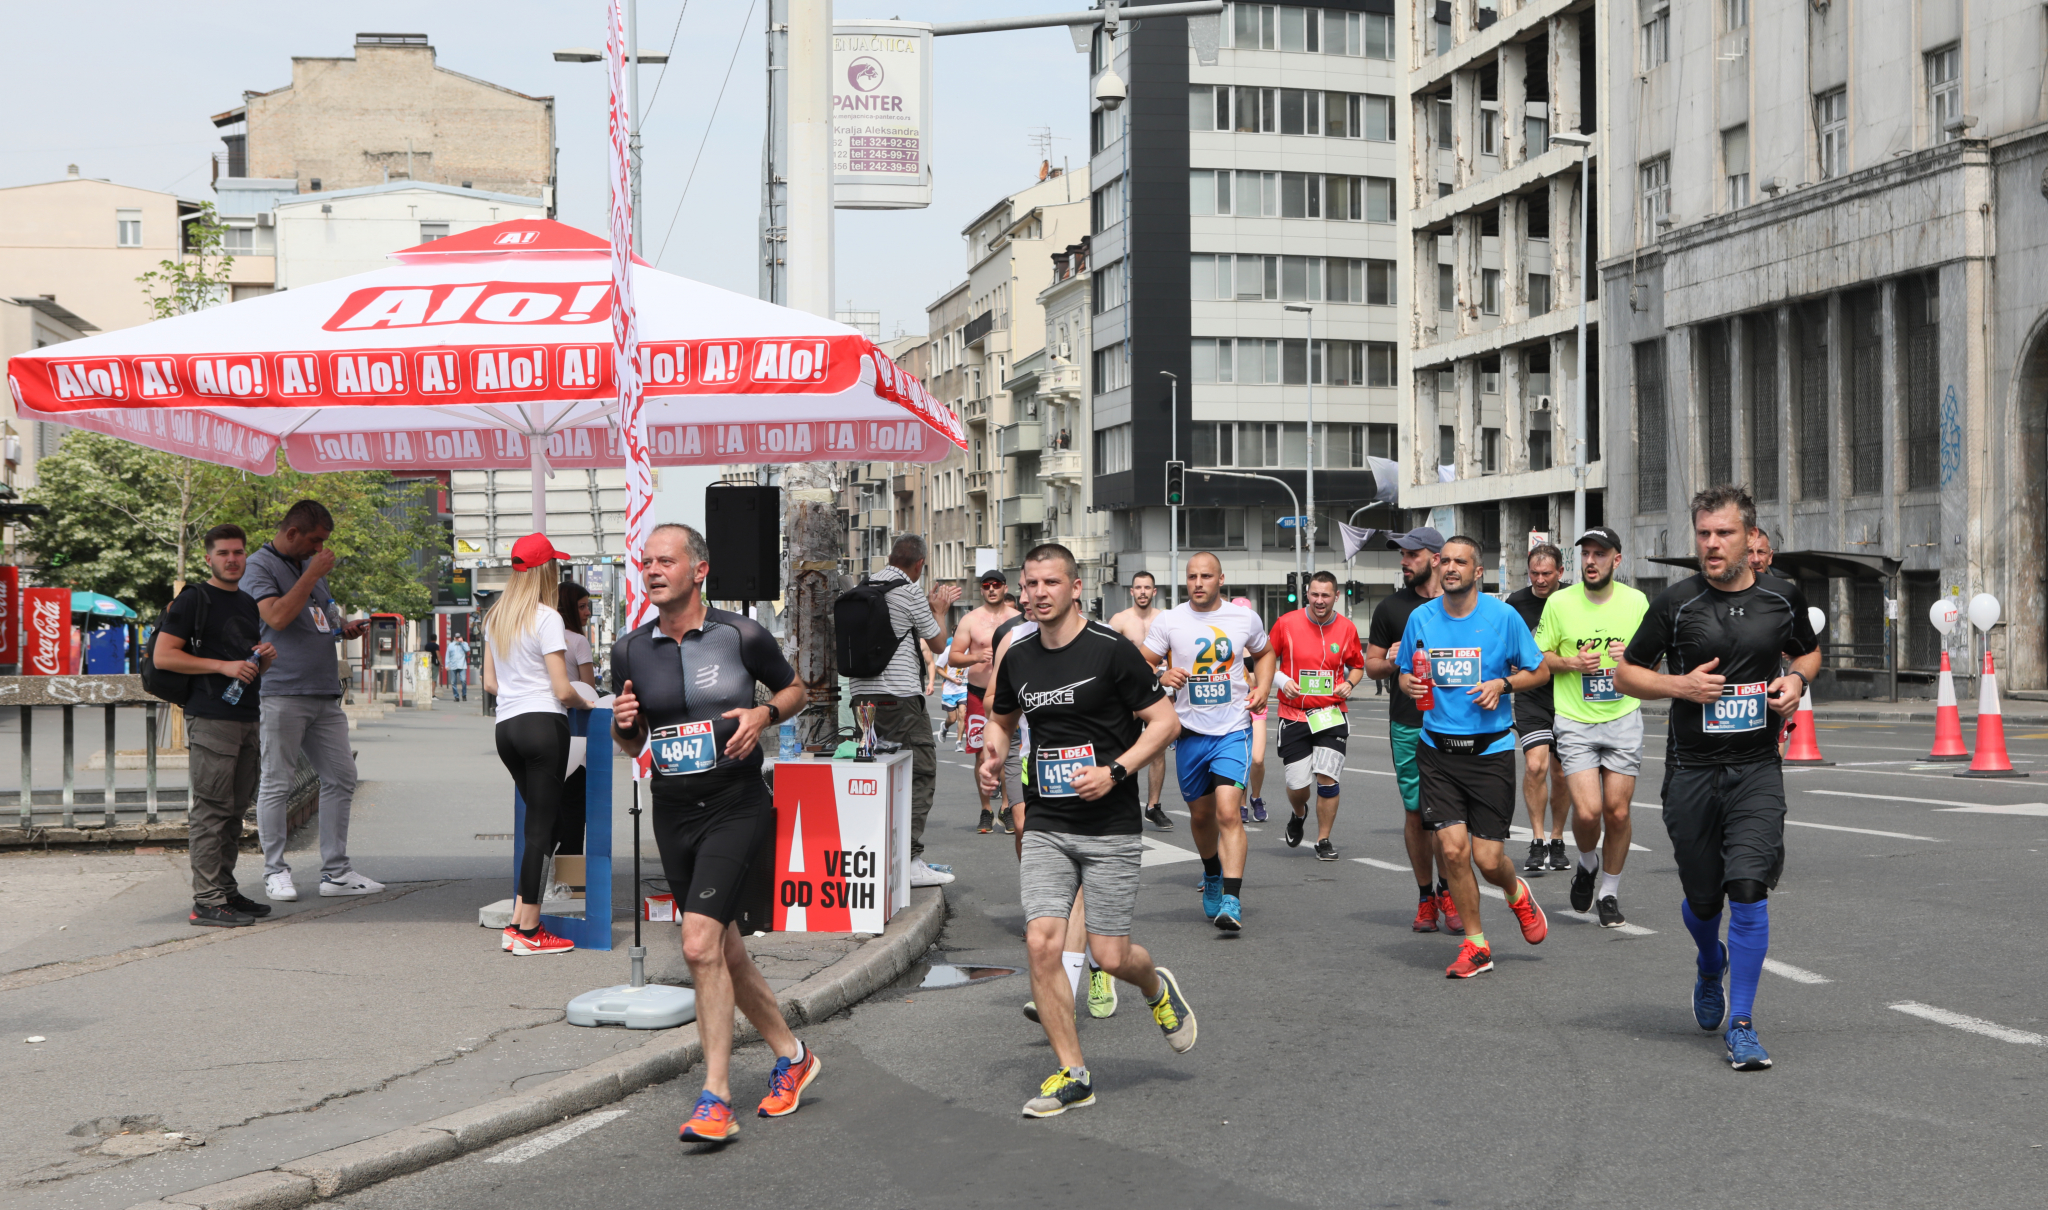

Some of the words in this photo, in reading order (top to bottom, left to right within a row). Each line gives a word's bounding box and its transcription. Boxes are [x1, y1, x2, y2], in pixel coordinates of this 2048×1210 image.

[833, 35, 915, 53] ENJAČNICA
[833, 94, 903, 112] PANTER
[833, 113, 911, 121] w.menjacnica-panter.co.rs
[834, 125, 862, 136] Kralja
[864, 125, 919, 137] Aleksandra
[851, 137, 867, 147] tel:
[869, 137, 918, 149] 324-92-62
[851, 149, 867, 159] tel:
[869, 149, 918, 160] 245-99-77
[851, 161, 867, 171] tel:
[869, 161, 918, 172] 242-39-59
[500, 232, 533, 244] A!
[336, 284, 612, 330] Alo!
[54, 361, 125, 399] Alo!
[140, 360, 178, 396] A!
[195, 358, 264, 396] Alo!
[282, 356, 317, 394] A!
[336, 355, 404, 394] Alo!
[421, 354, 457, 393] A!
[476, 350, 544, 391] Alo!
[561, 348, 596, 387] A!
[641, 346, 686, 384] lo!
[702, 344, 738, 382] A!
[753, 342, 825, 381] Alo!
[1437, 660, 1472, 677] 6429
[1194, 683, 1226, 698] 6358
[1308, 679, 1320, 688] R3
[1324, 679, 1331, 689] 4
[1589, 678, 1615, 693] 563
[1024, 689, 1075, 708] NIKE
[1714, 698, 1758, 719] 6078
[661, 738, 703, 763] 4847
[850, 779, 876, 795] Alo!
[823, 845, 876, 878] VEĆI
[780, 879, 813, 908] OD
[820, 881, 875, 909] SVIH
